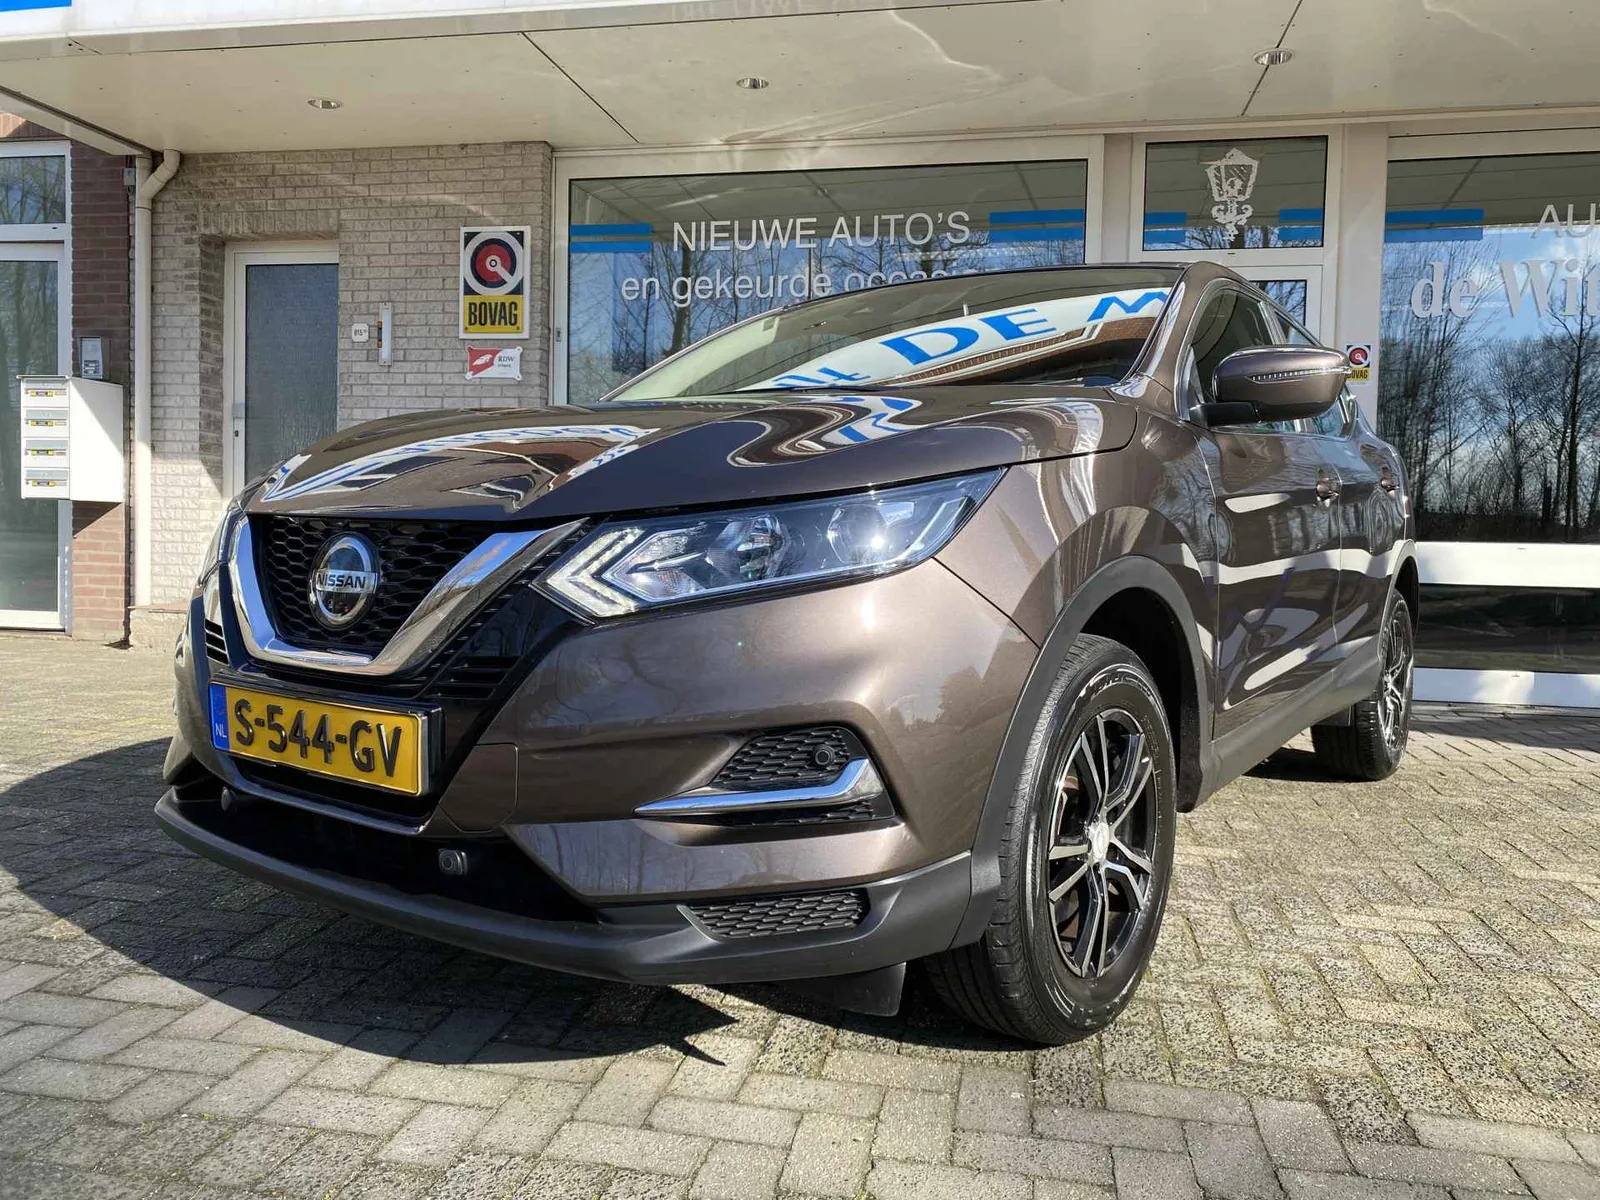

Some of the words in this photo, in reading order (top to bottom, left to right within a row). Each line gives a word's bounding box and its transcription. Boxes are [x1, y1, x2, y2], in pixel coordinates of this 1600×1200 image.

[673, 218, 817, 251] NIEUWE
[828, 211, 970, 248] AUTO'S
[1531, 203, 1600, 238] AU
[621, 276, 660, 300] en
[672, 263, 833, 307] gekeurde
[1411, 261, 1480, 318] de
[468, 301, 518, 326] BOVAG
[316, 572, 367, 589] NISSAN
[215, 723, 228, 739] NL
[234, 698, 402, 778] S-544-GV
